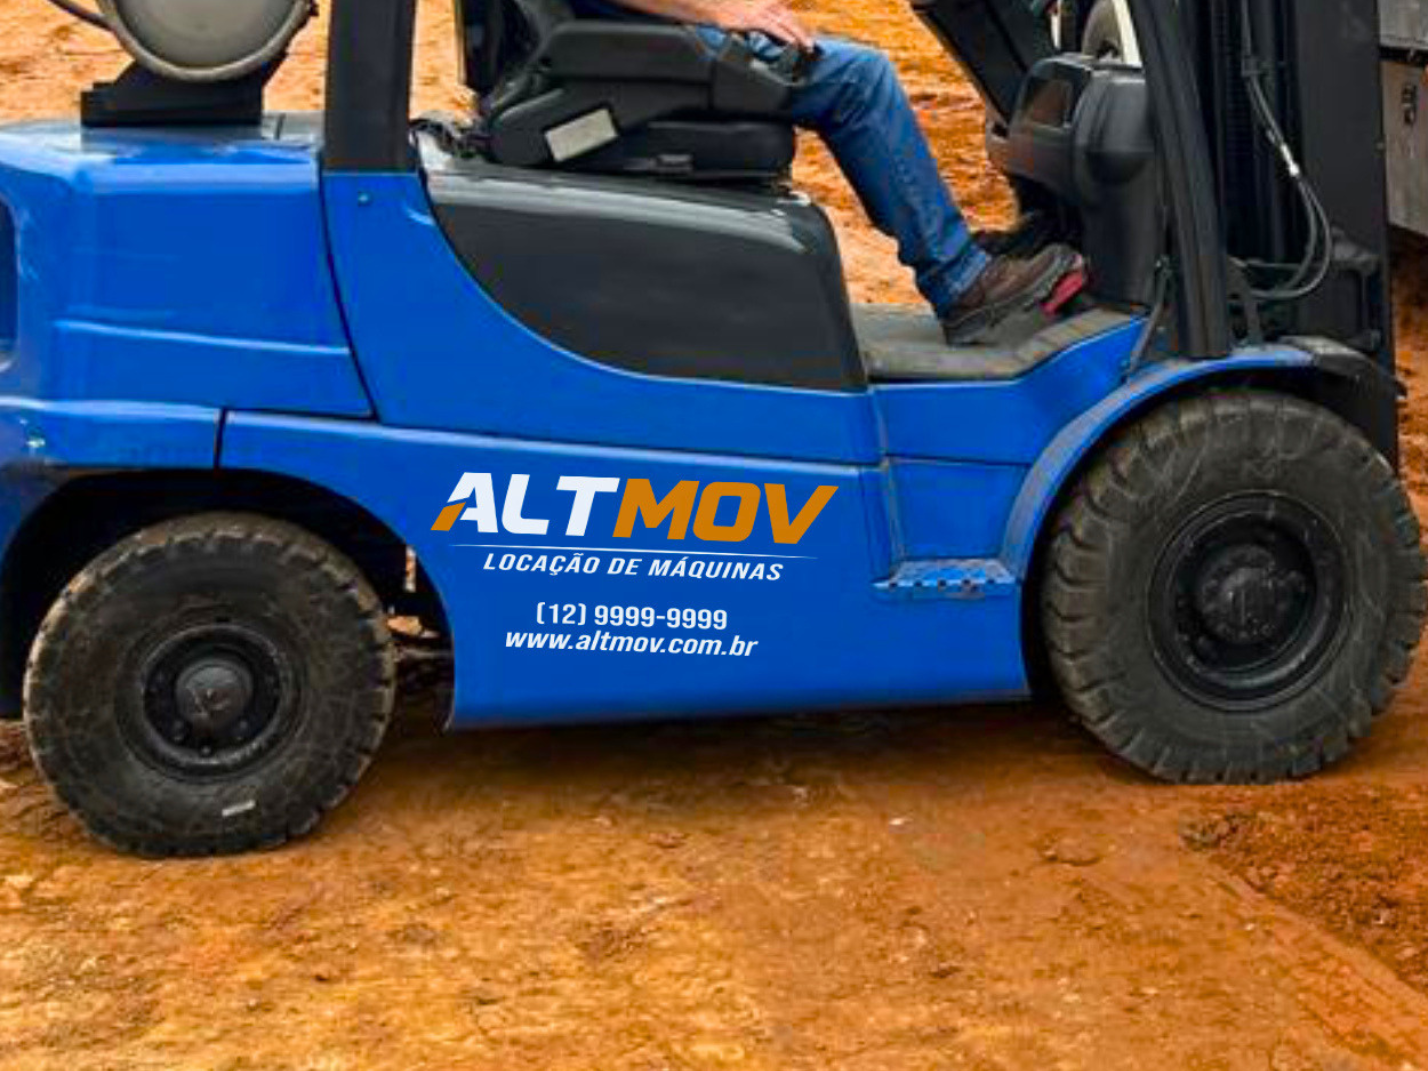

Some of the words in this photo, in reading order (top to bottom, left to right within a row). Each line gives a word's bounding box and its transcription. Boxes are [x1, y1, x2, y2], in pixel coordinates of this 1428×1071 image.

[430, 471, 839, 545] ALTMOV
[483, 552, 601, 576] LOCAÇÃO
[606, 557, 643, 576] DE
[647, 556, 784, 581] MÁQUINAS
[536, 601, 587, 626] (12)
[594, 604, 728, 631] 9999-9999
[505, 629, 759, 657] www.altmov.com.br
